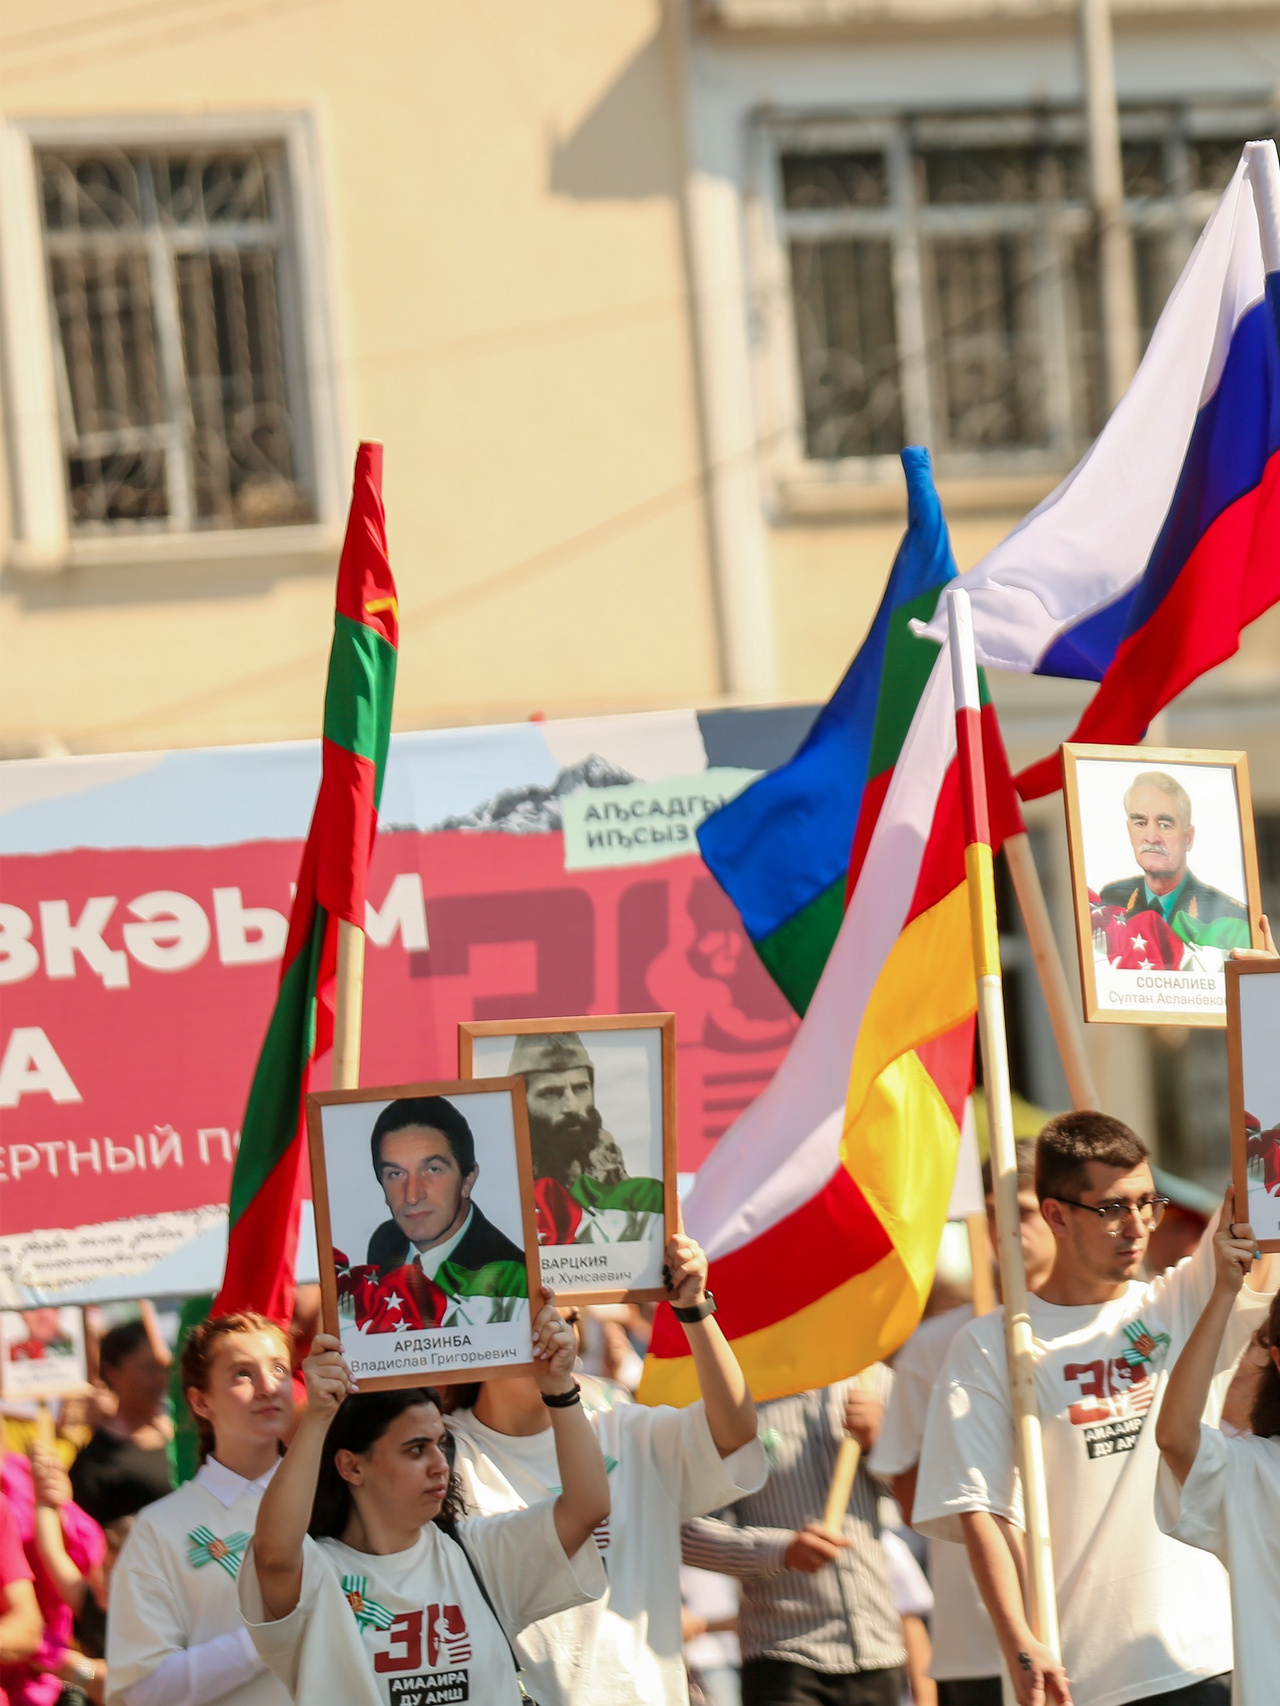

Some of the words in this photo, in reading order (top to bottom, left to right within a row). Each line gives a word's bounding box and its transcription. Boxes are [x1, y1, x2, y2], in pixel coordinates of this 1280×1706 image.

[1136, 976, 1216, 990] СОСНАЛИЕВ
[1109, 991, 1153, 1005] Султан
[541, 1255, 607, 1270] ВАРЦКИЯ
[394, 1334, 472, 1353] АРДЗИНБА
[351, 1357, 428, 1373] Владислав
[431, 1348, 517, 1367] Григорьевич
[1086, 1416, 1146, 1442] АИААИР
[391, 1671, 468, 1692] АИААИРА
[400, 1693, 423, 1706] ДУ
[425, 1688, 463, 1705] АМШ
